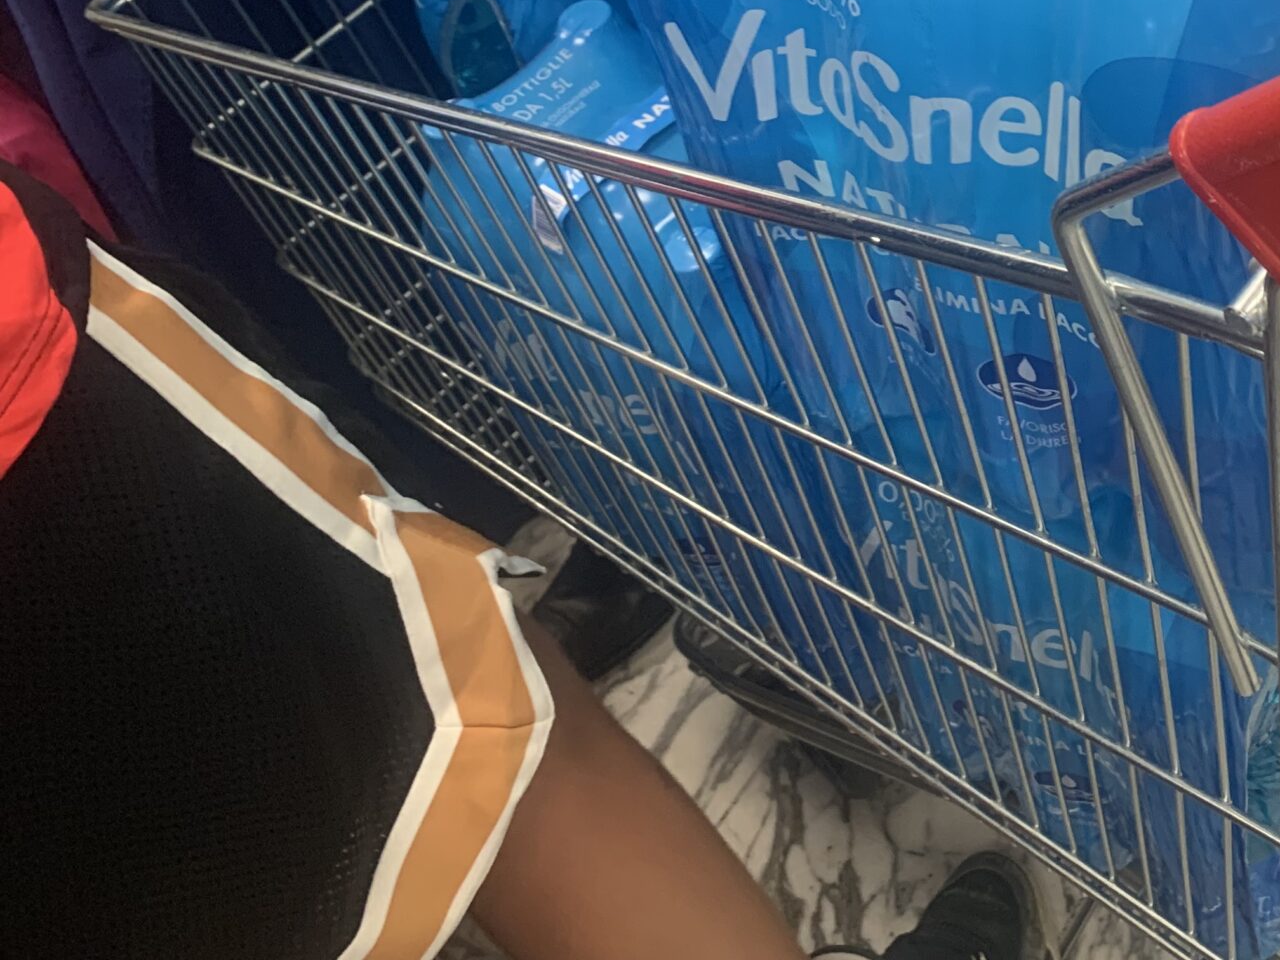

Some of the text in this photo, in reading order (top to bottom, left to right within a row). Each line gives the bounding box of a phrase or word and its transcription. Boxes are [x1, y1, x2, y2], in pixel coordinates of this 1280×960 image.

[491, 47, 574, 113] BOTTIGLIE
[512, 101, 545, 122] DA
[664, 9, 1143, 226] VitaSnella
